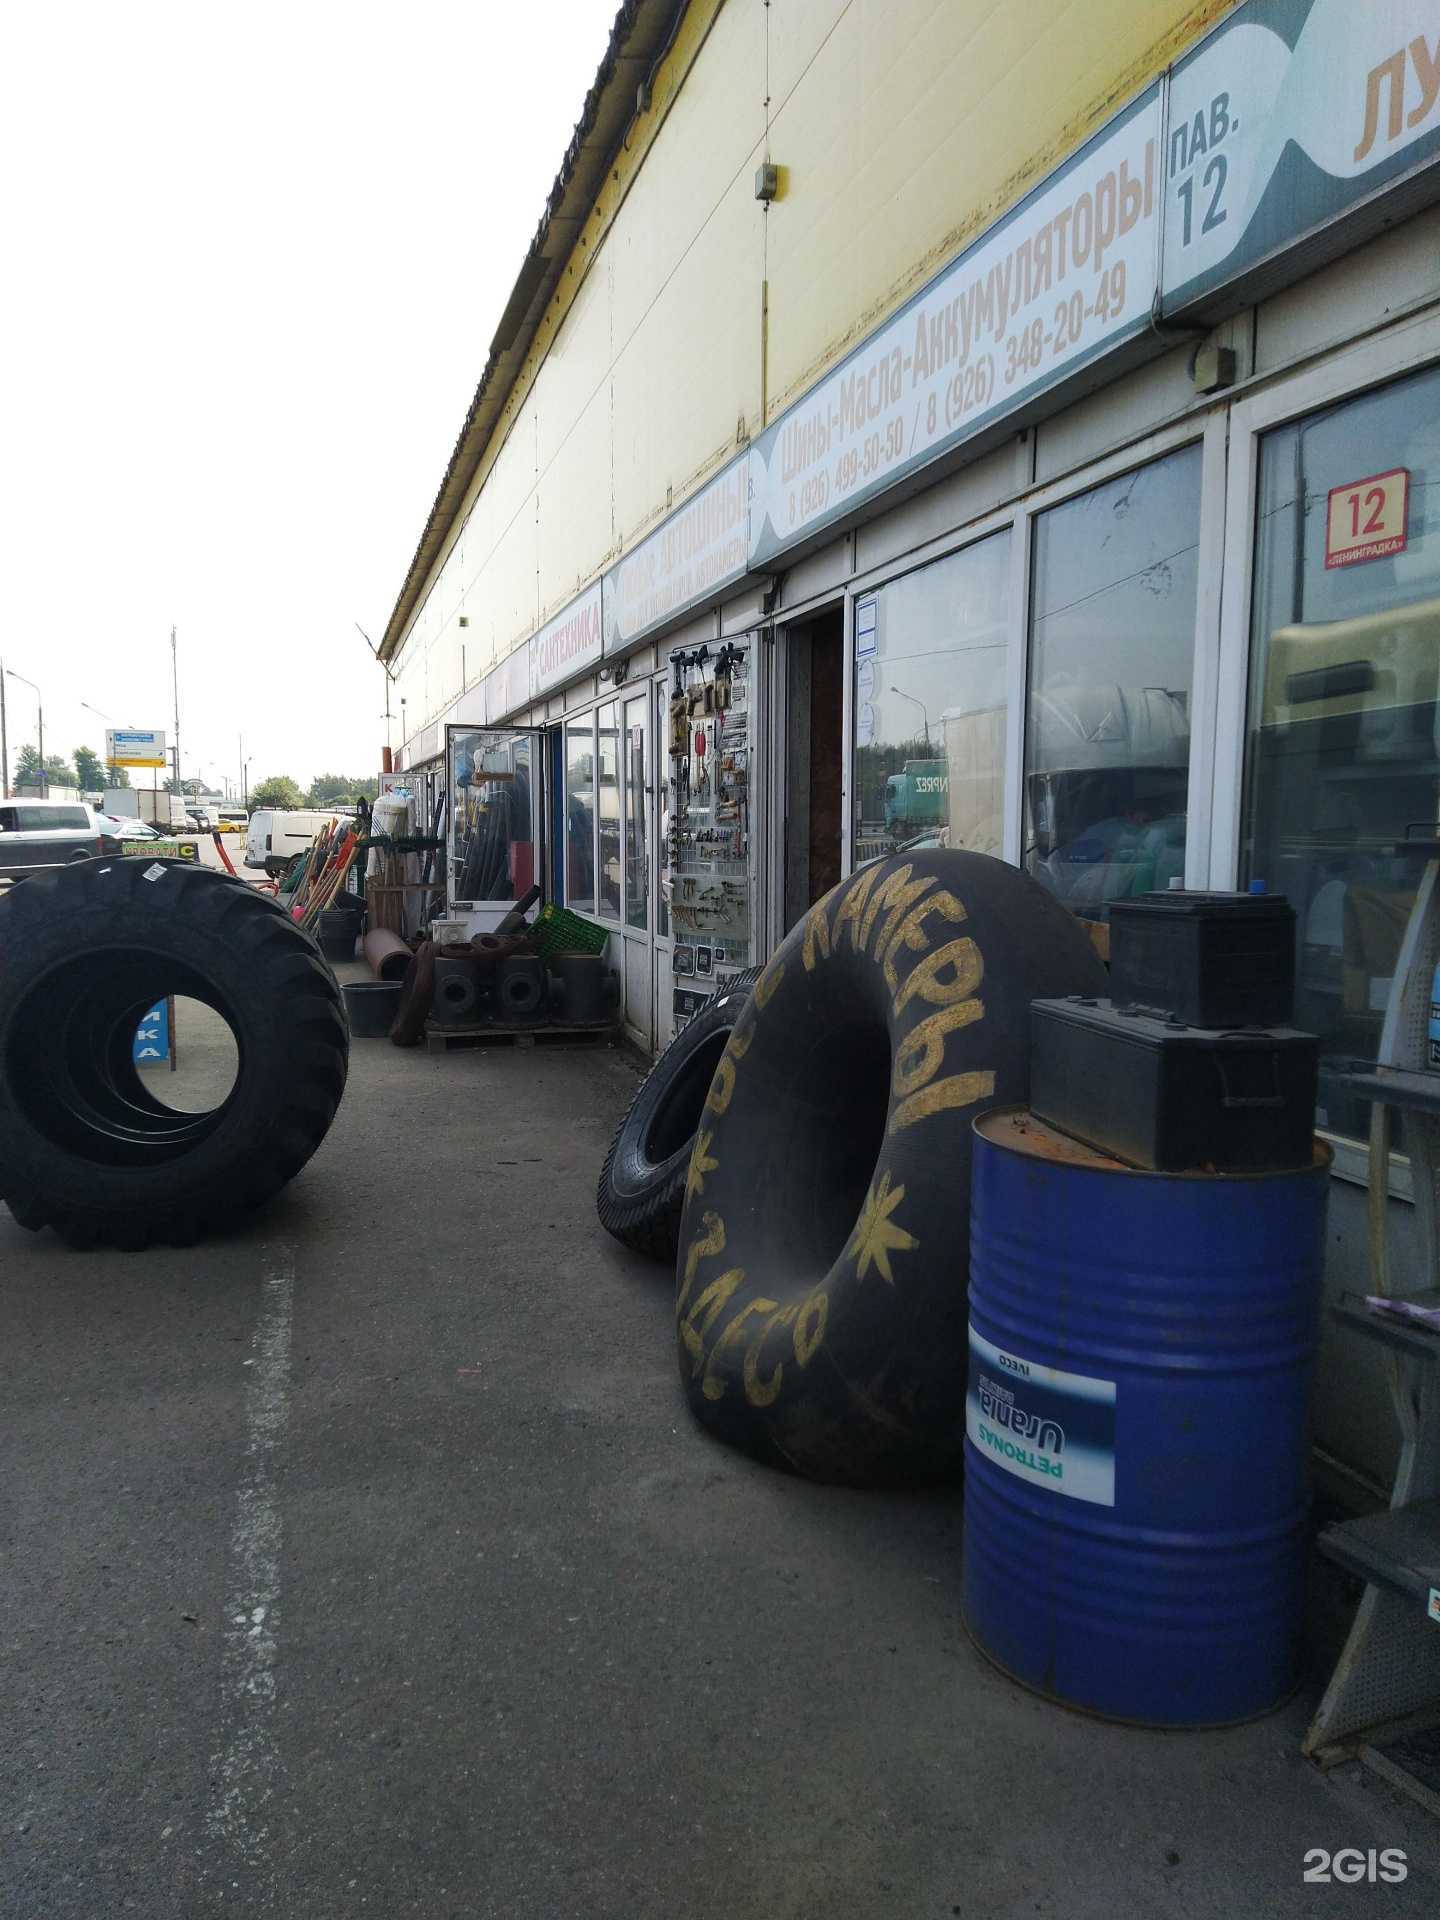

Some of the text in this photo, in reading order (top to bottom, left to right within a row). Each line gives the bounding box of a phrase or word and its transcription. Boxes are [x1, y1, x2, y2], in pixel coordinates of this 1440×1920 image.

[1170, 91, 1239, 178] ПАВ.
[1177, 154, 1228, 248] 12
[799, 469, 830, 521] (926)
[834, 415, 904, 494] 499-50-50
[927, 391, 937, 435] 8
[945, 352, 995, 426] (926)
[1004, 259, 1127, 385] 348-20-49
[1348, 487, 1386, 538] 12
[536, 601, 600, 677] САНТЕХНИКА
[999, 1354, 1030, 1377] IVECO
[977, 1386, 1066, 1455] Urania
[979, 1423, 1064, 1479] PETRONAS
